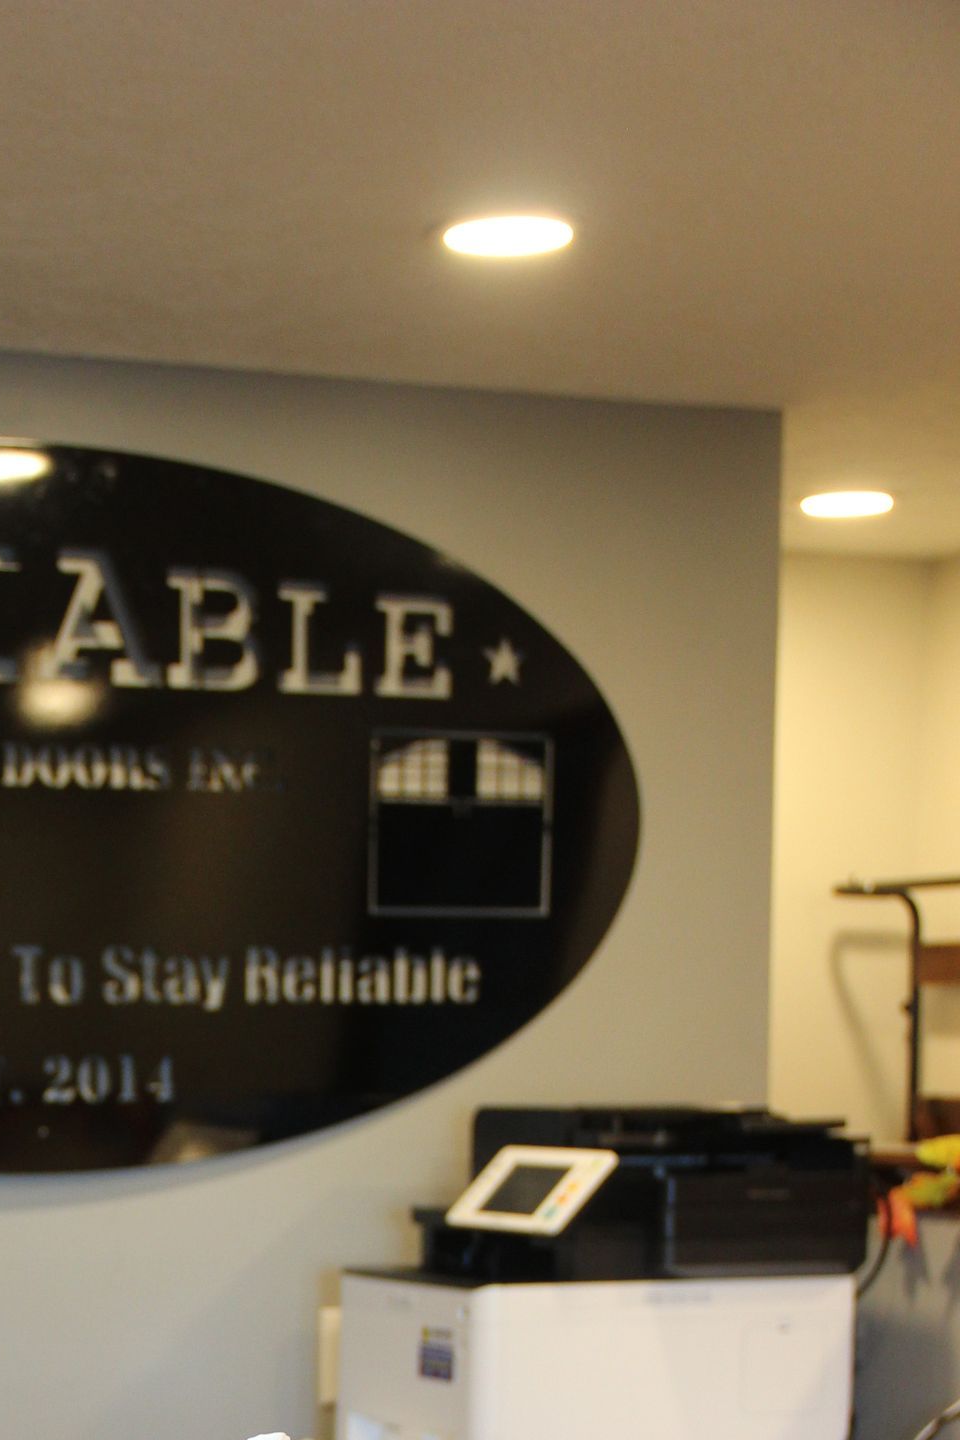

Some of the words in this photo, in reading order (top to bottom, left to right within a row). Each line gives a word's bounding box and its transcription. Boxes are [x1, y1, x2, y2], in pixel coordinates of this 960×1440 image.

[0, 741, 171, 791] DOORS
[12, 945, 85, 1006] To
[101, 945, 230, 1012] Stay
[244, 946, 482, 1005] Reliable
[42, 1053, 175, 1103] 2014
